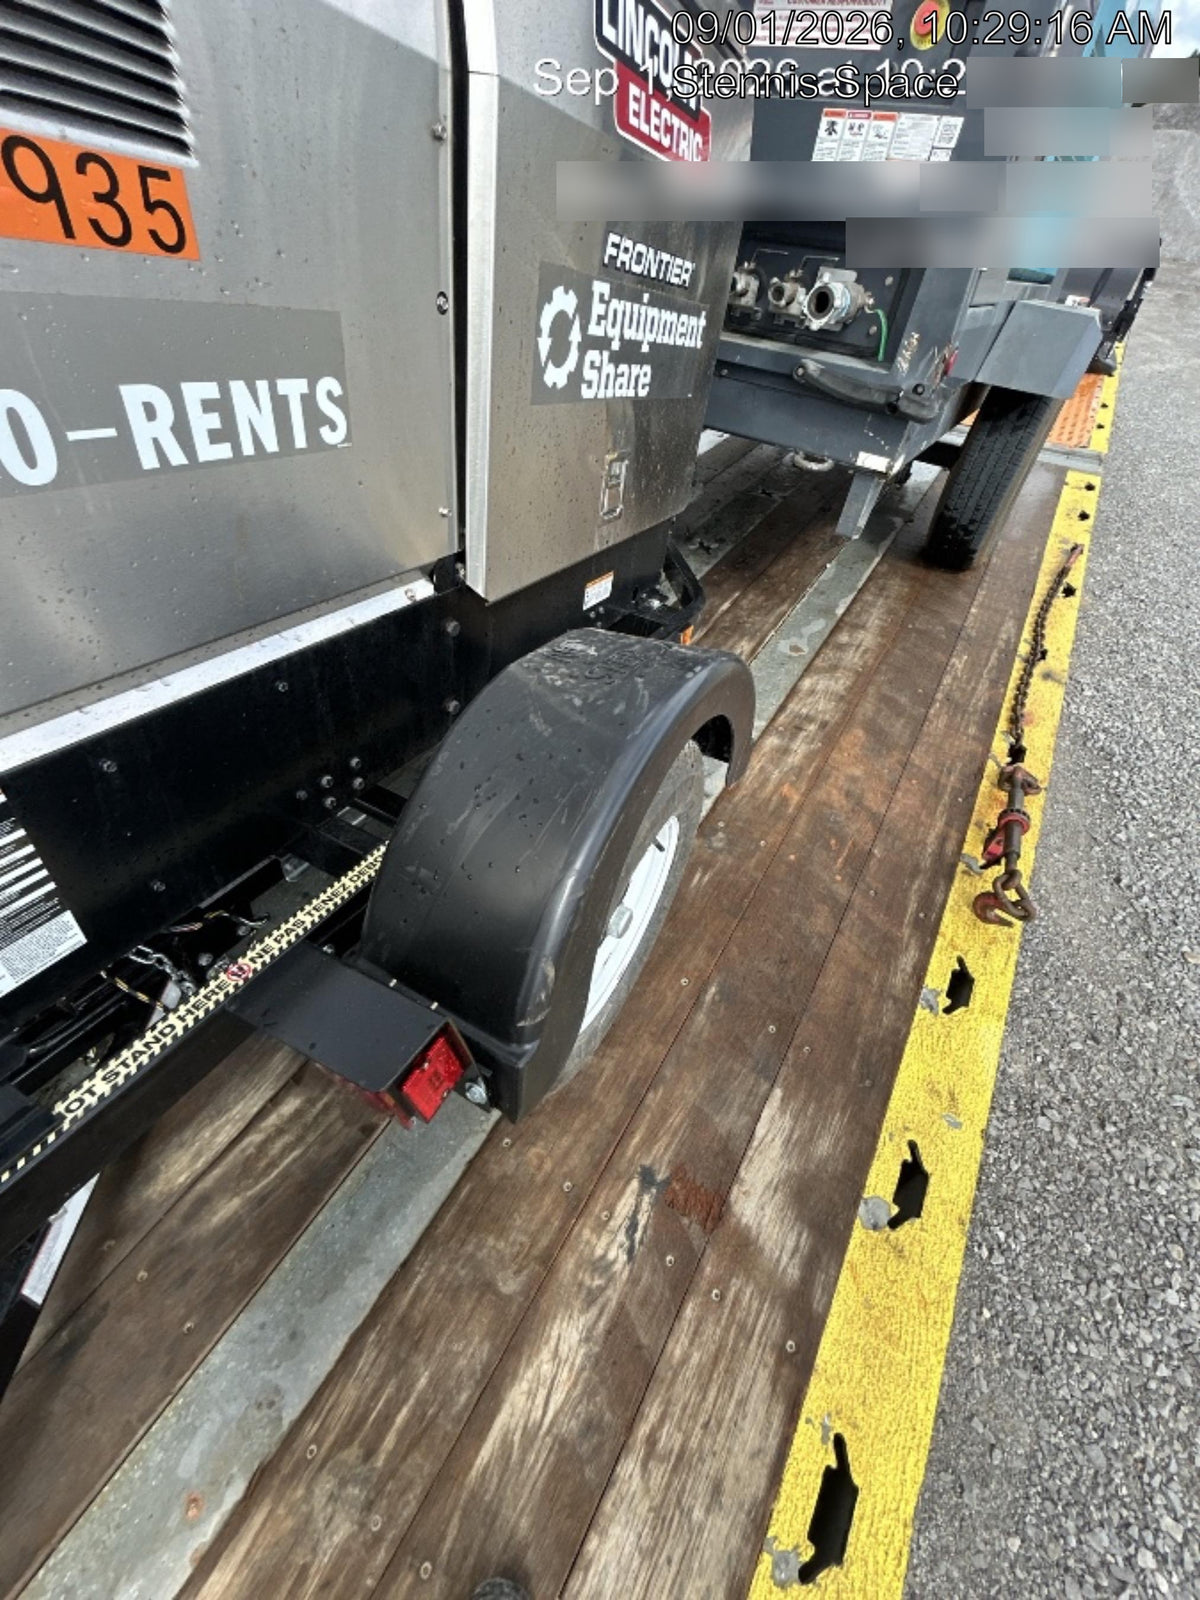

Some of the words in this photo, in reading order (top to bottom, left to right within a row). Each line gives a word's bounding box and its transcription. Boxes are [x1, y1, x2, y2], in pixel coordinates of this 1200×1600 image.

[628, 81, 703, 161] ELECTRIC
[0, 134, 187, 255] 935
[603, 231, 695, 289] FRONTIER
[586, 279, 707, 353] Equipment
[580, 349, 652, 400] Share
[248, 944, 274, 965] NE
[273, 918, 306, 945] PAS
[303, 882, 351, 918] TENEZ
[64, 1084, 98, 1115] OT
[101, 1023, 178, 1084] STAND
[177, 979, 232, 1023] HERE
